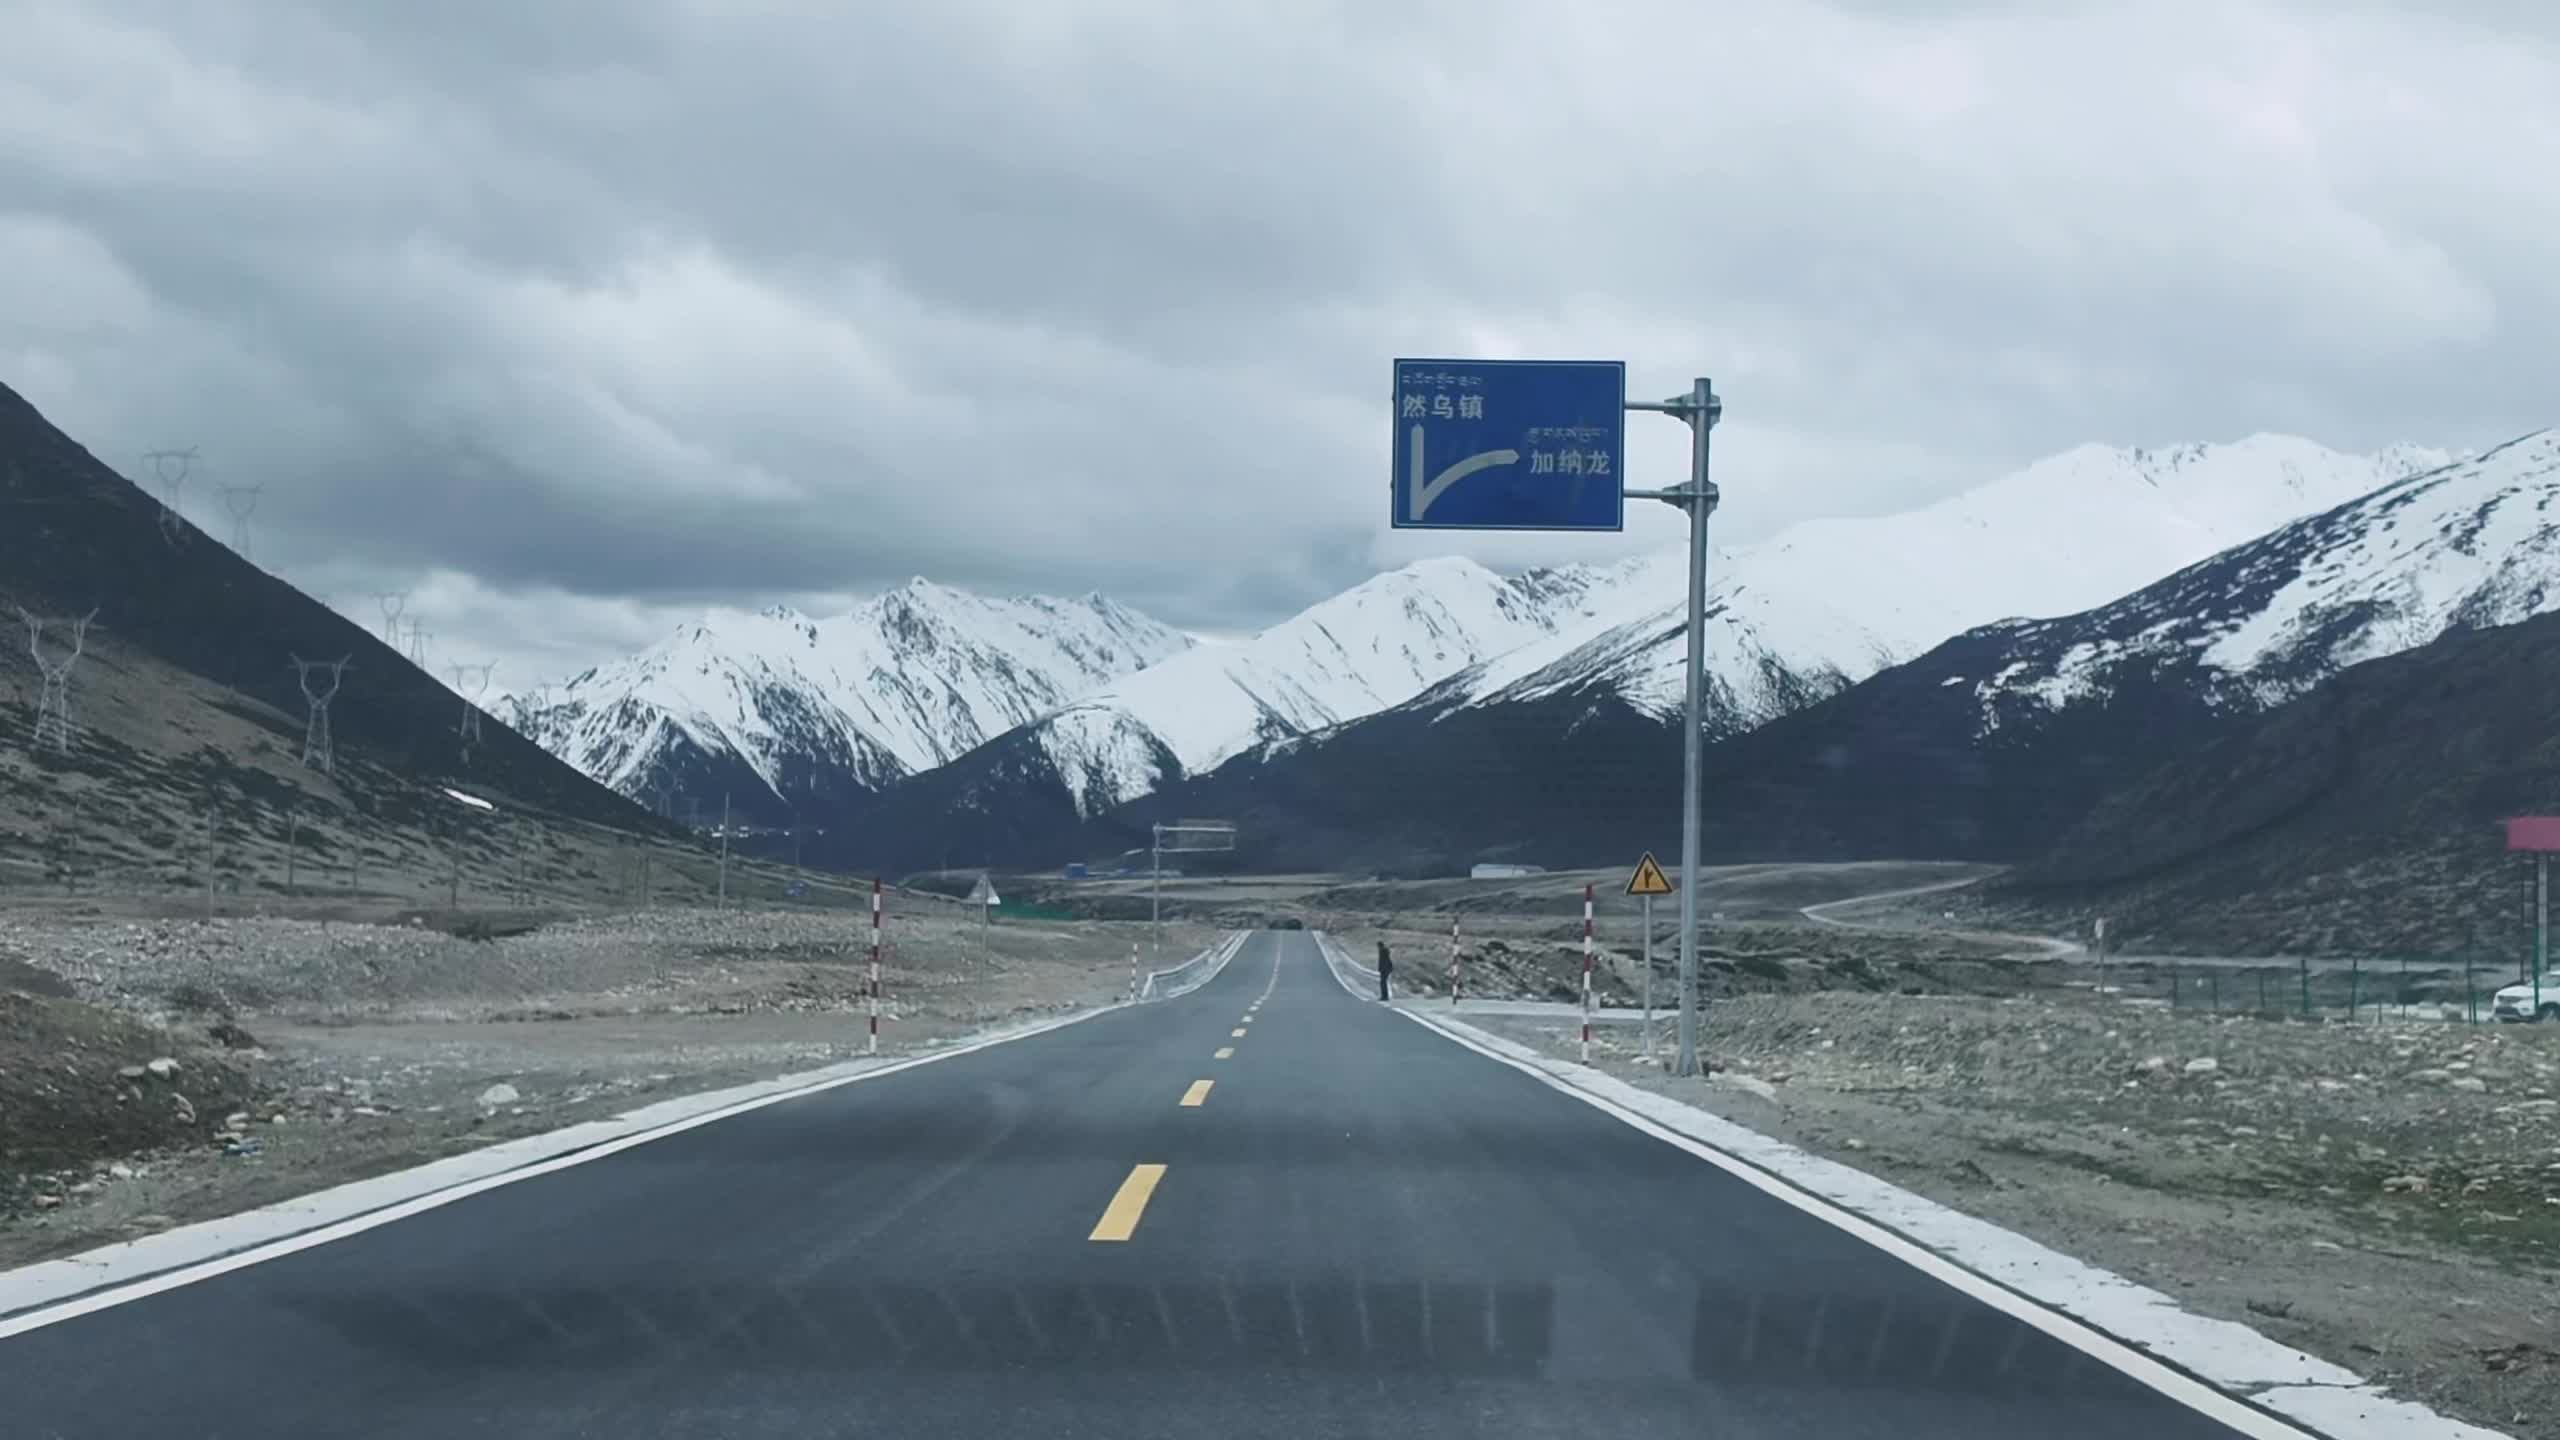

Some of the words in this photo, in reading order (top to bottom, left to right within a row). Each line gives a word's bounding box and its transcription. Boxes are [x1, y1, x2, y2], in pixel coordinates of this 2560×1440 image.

[1402, 394, 1484, 419] 然乌镇
[1530, 448, 1611, 475] 加纳龙
